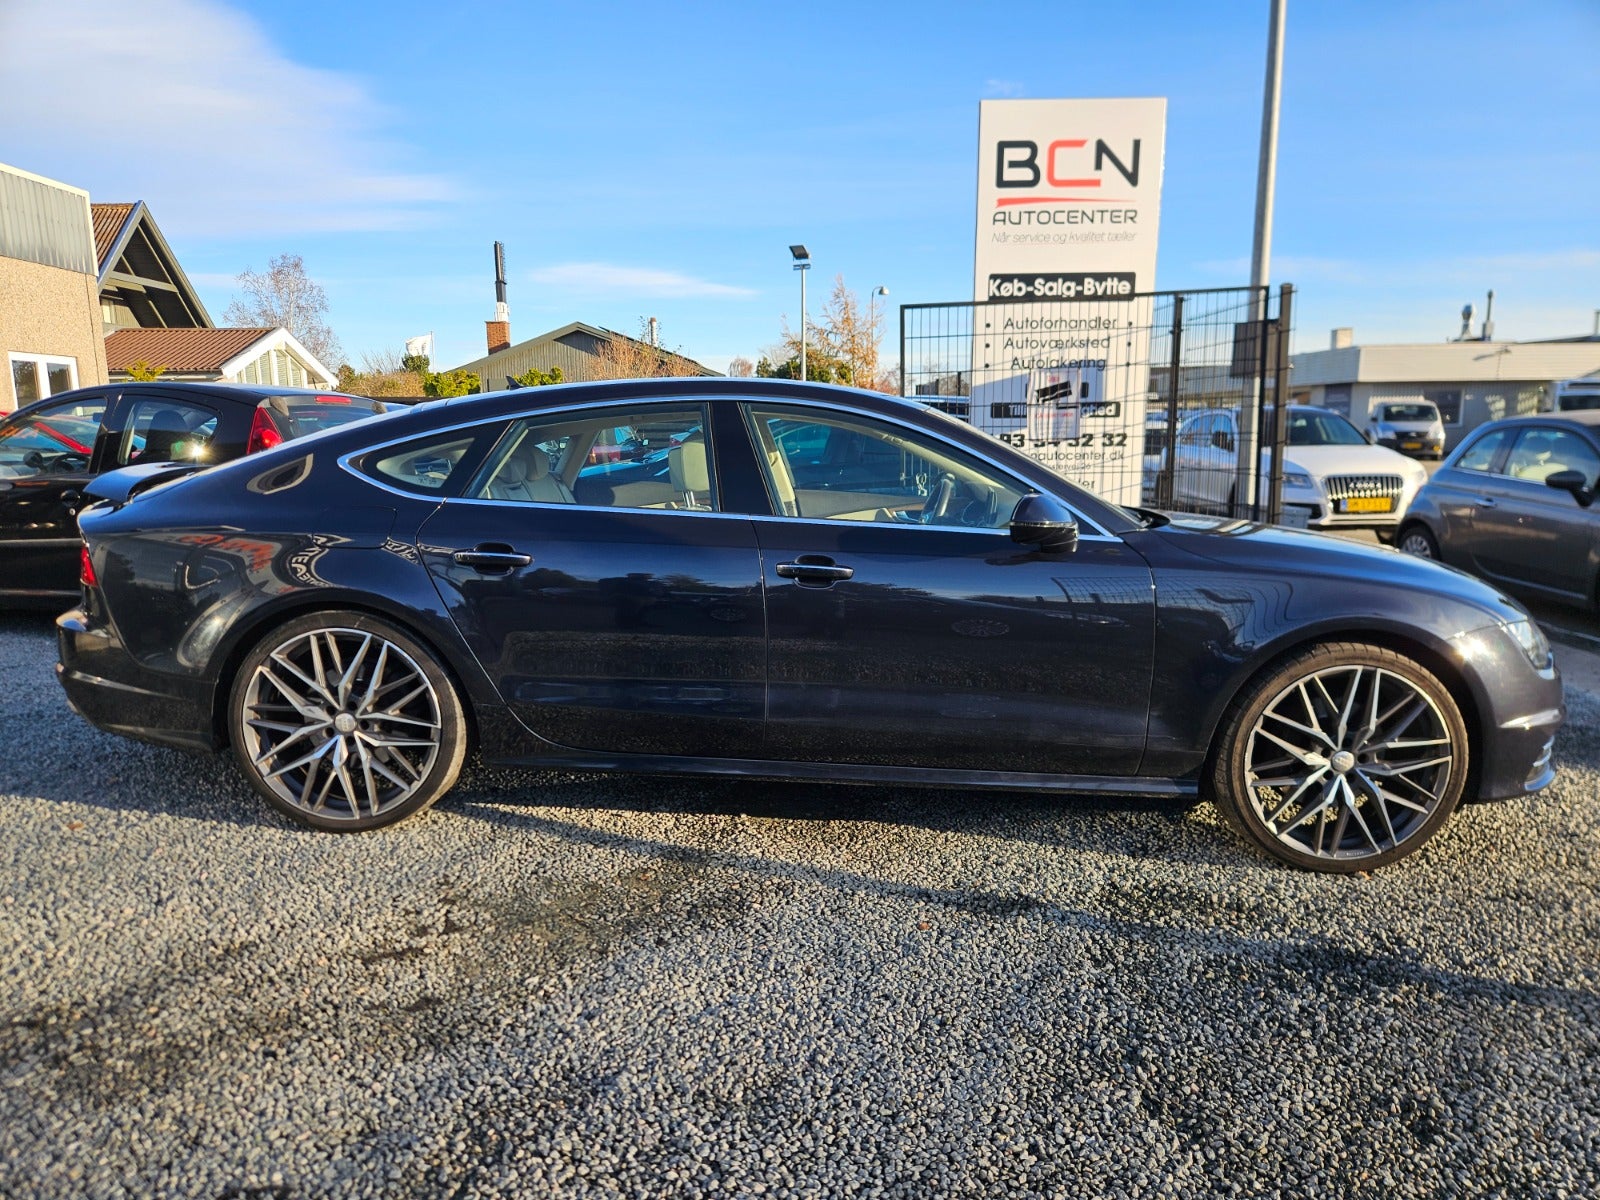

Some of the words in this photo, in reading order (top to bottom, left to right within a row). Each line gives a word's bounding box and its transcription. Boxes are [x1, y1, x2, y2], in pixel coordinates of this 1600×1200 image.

[995, 138, 1141, 188] BCN
[992, 209, 1138, 226] AUTOCENTER
[991, 231, 1010, 243] Når
[1012, 232, 1051, 243] service
[1052, 234, 1067, 245] og
[1068, 231, 1106, 242] kvalitet
[1004, 316, 1117, 330] Autoforhandler
[1004, 336, 1111, 350] Autoværksted
[1010, 356, 1107, 372] Autolakering
[1080, 403, 1117, 418] ghed
[1102, 433, 1127, 447] 32
[1030, 450, 1124, 461] nautocenter.dk
